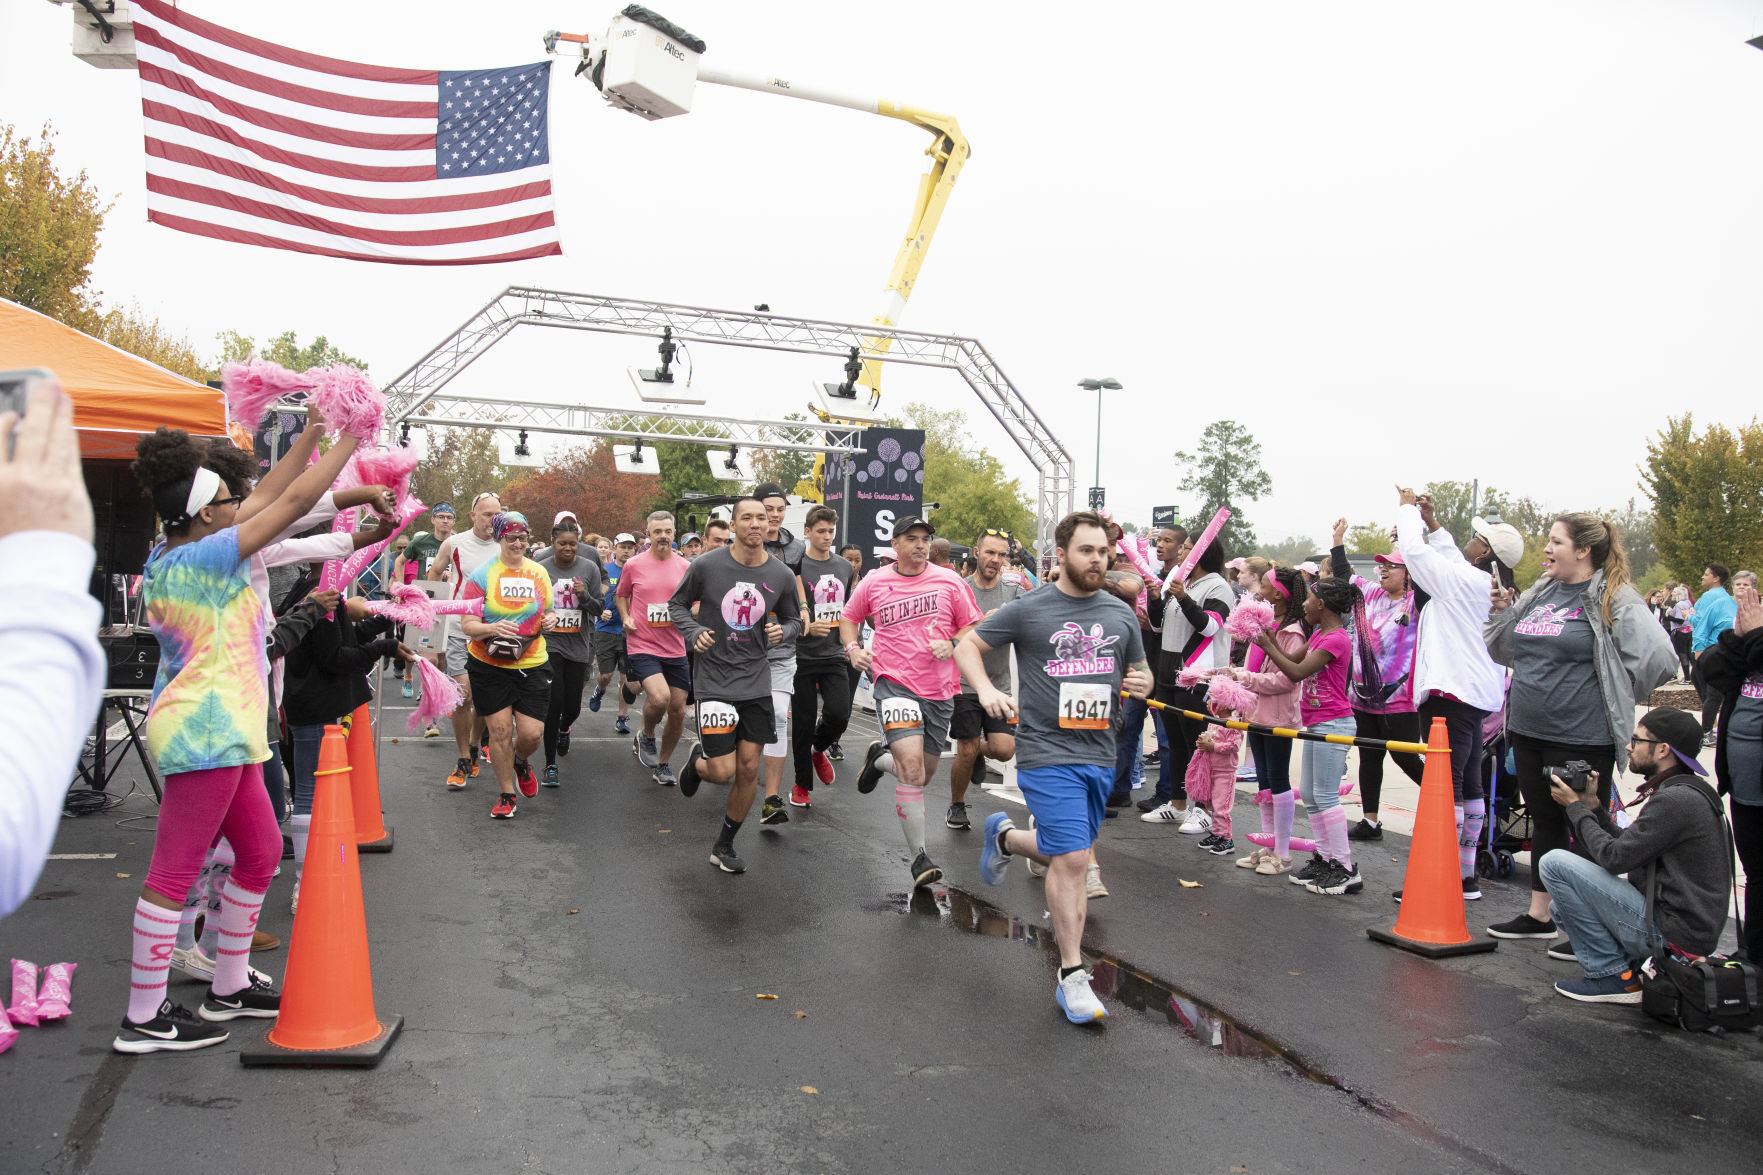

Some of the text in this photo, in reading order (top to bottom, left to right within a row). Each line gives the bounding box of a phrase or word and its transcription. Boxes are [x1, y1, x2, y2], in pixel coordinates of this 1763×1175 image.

[664, 41, 685, 61] Altec
[327, 560, 336, 591] NCER
[503, 586, 533, 598] 2027
[880, 594, 938, 624] GET IN PINK
[555, 617, 580, 629] 2154
[1047, 657, 1114, 676] DEFENDERS
[884, 708, 919, 724] 2063
[1064, 699, 1108, 722] 1947
[702, 712, 736, 729] 2053
